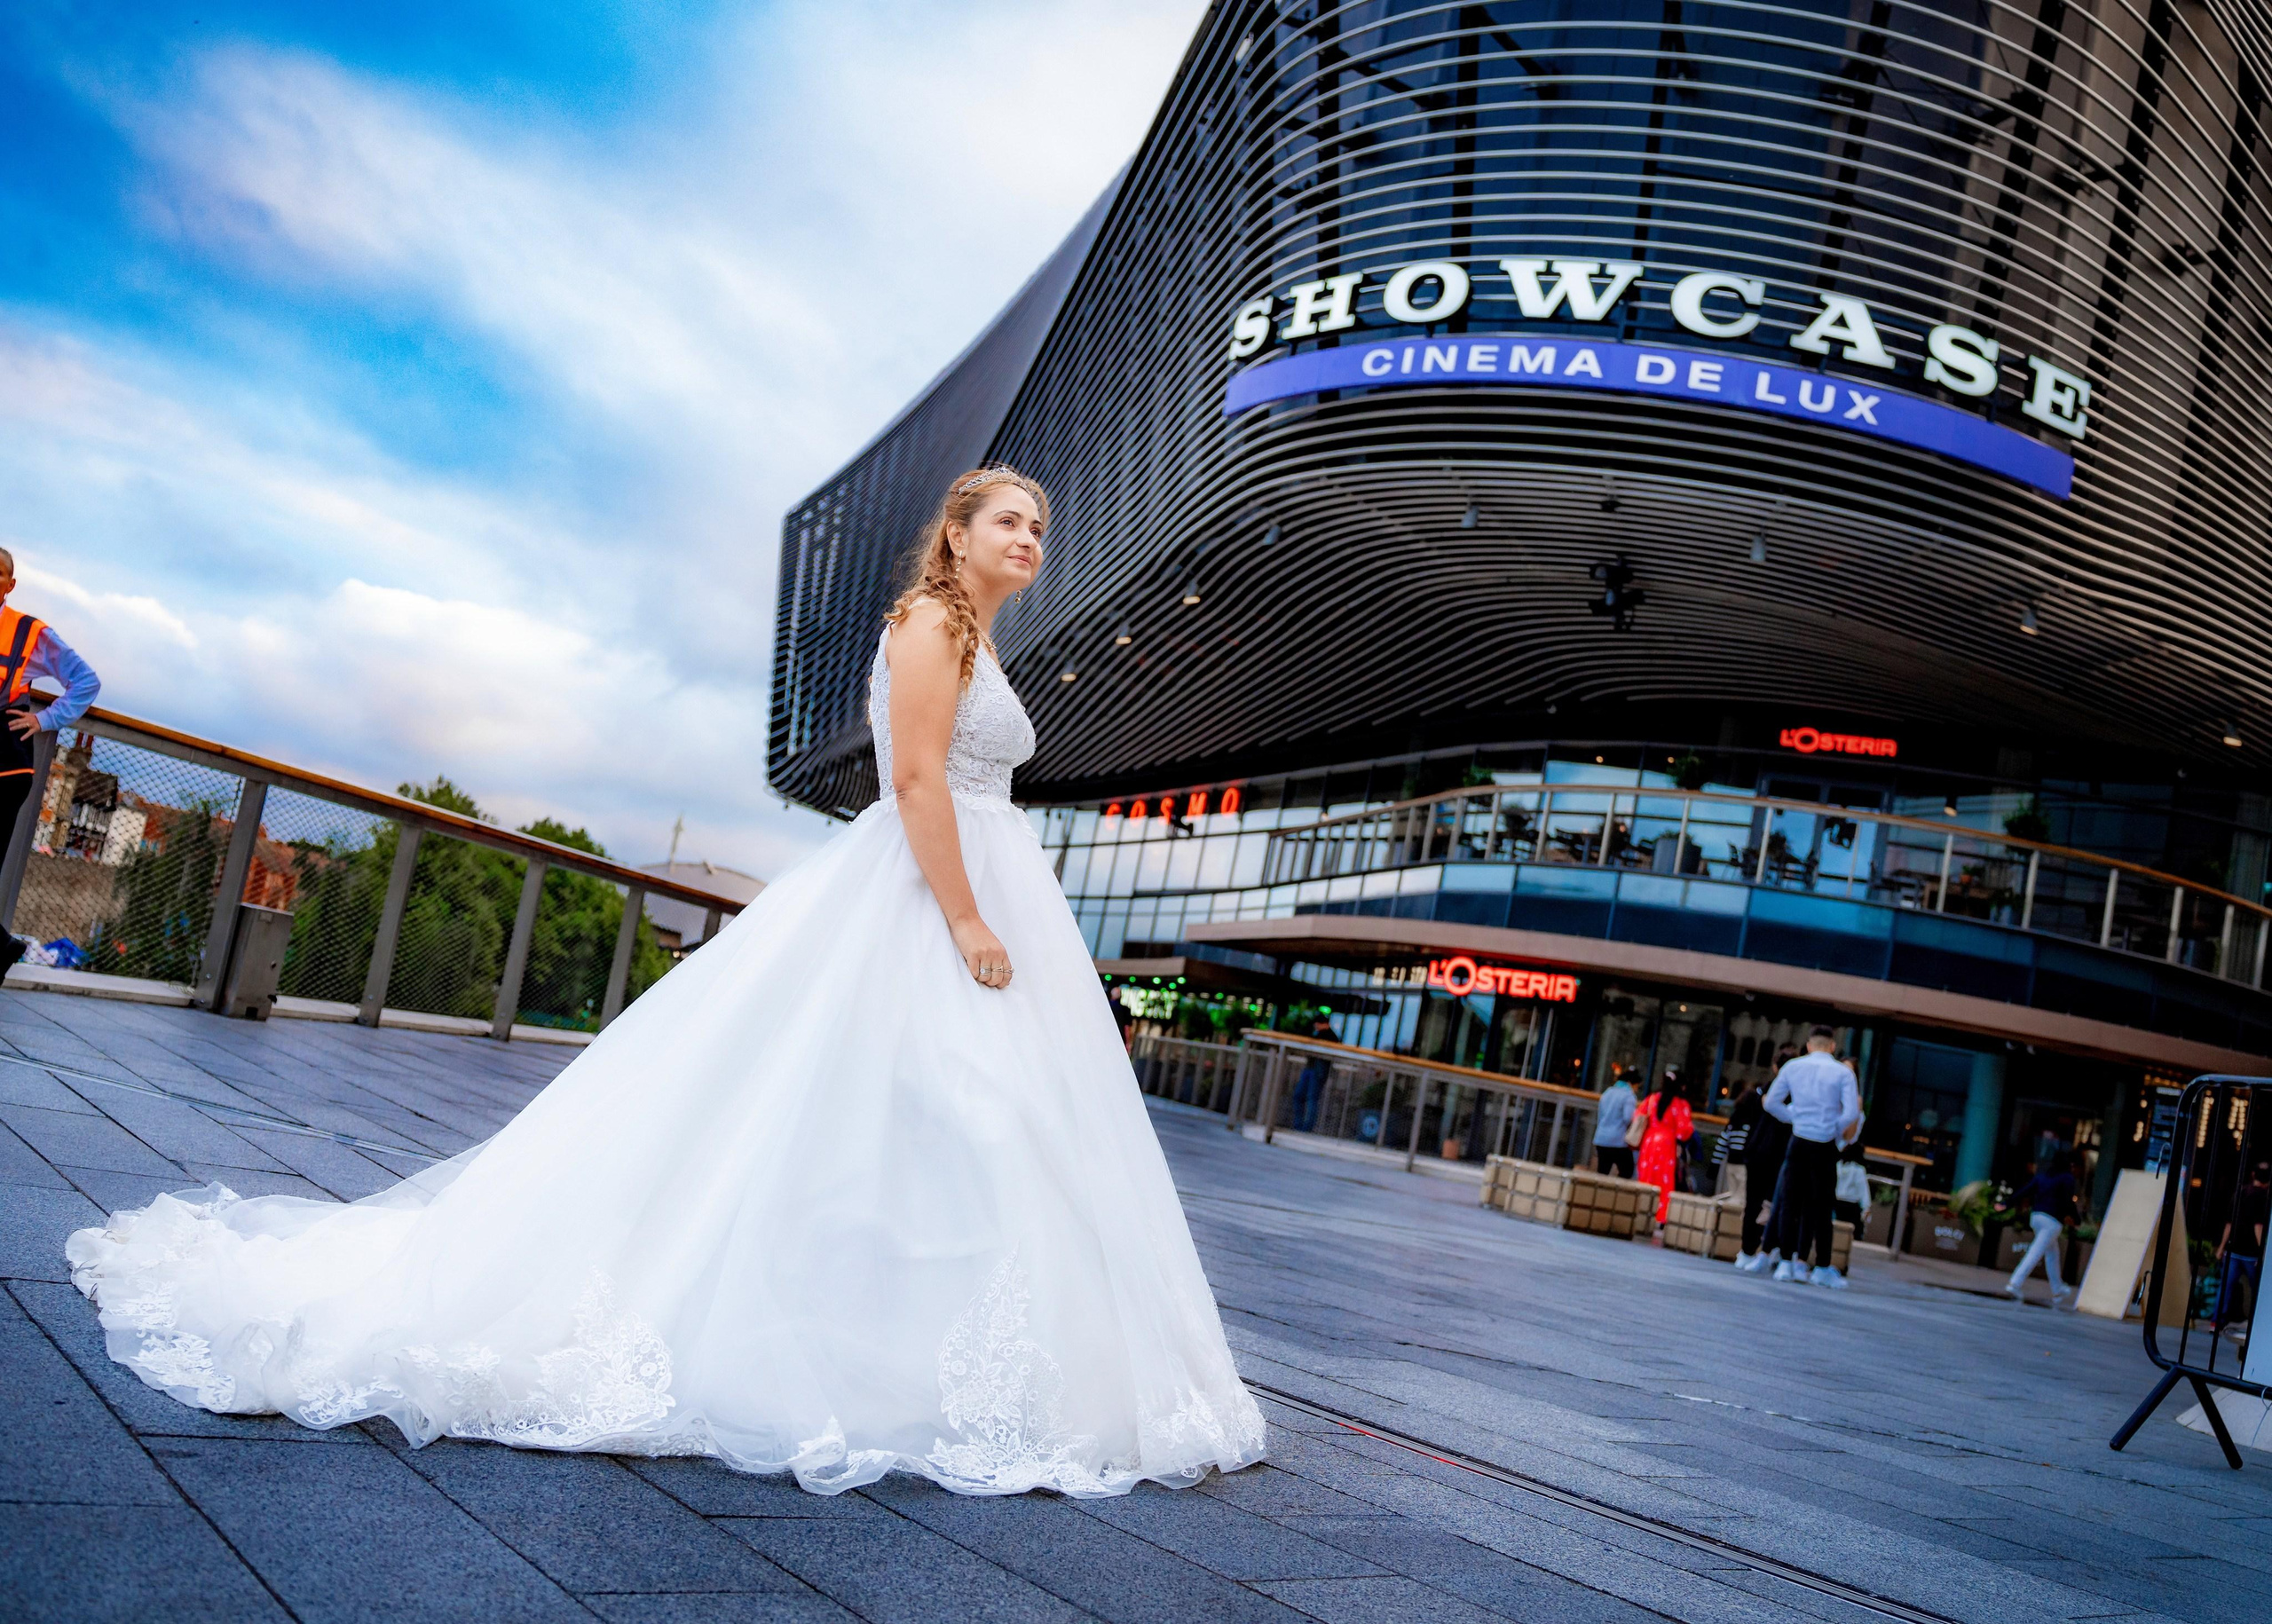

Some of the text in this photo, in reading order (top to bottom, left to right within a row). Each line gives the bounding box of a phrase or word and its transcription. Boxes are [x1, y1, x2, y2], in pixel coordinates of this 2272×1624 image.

[1228, 259, 2091, 441] SHOWCASE
[1361, 344, 1881, 425] CINEMA DE LUX
[1779, 727, 1897, 757] L'OSTERIA
[1105, 786, 1240, 829] COSMO
[1428, 956, 1577, 1003] L'OSTERIA
